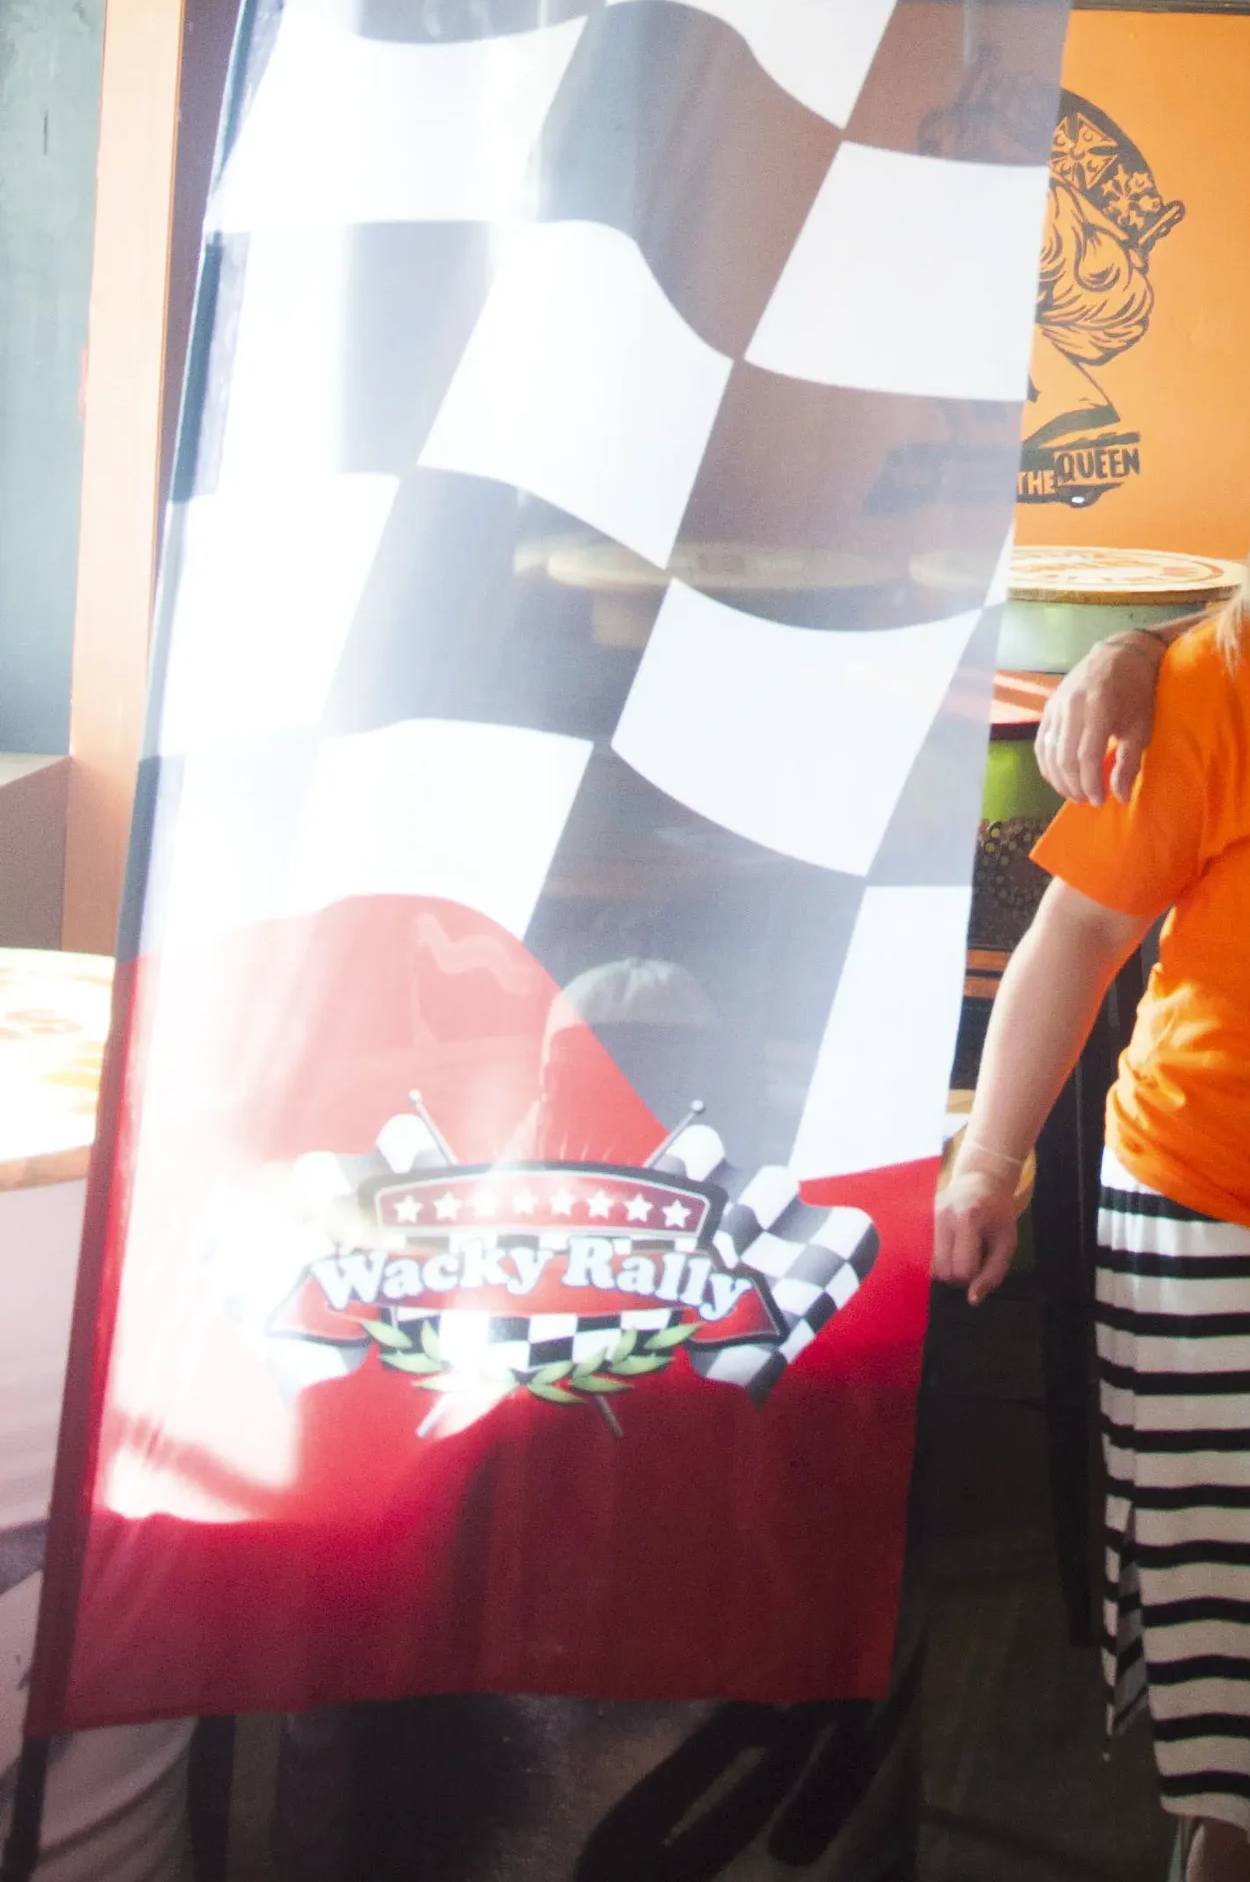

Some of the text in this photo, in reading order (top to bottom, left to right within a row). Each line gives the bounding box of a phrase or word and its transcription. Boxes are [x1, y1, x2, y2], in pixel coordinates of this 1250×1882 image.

[1057, 447, 1141, 482] QUEEN
[309, 1235, 753, 1321] Wacky Rally
